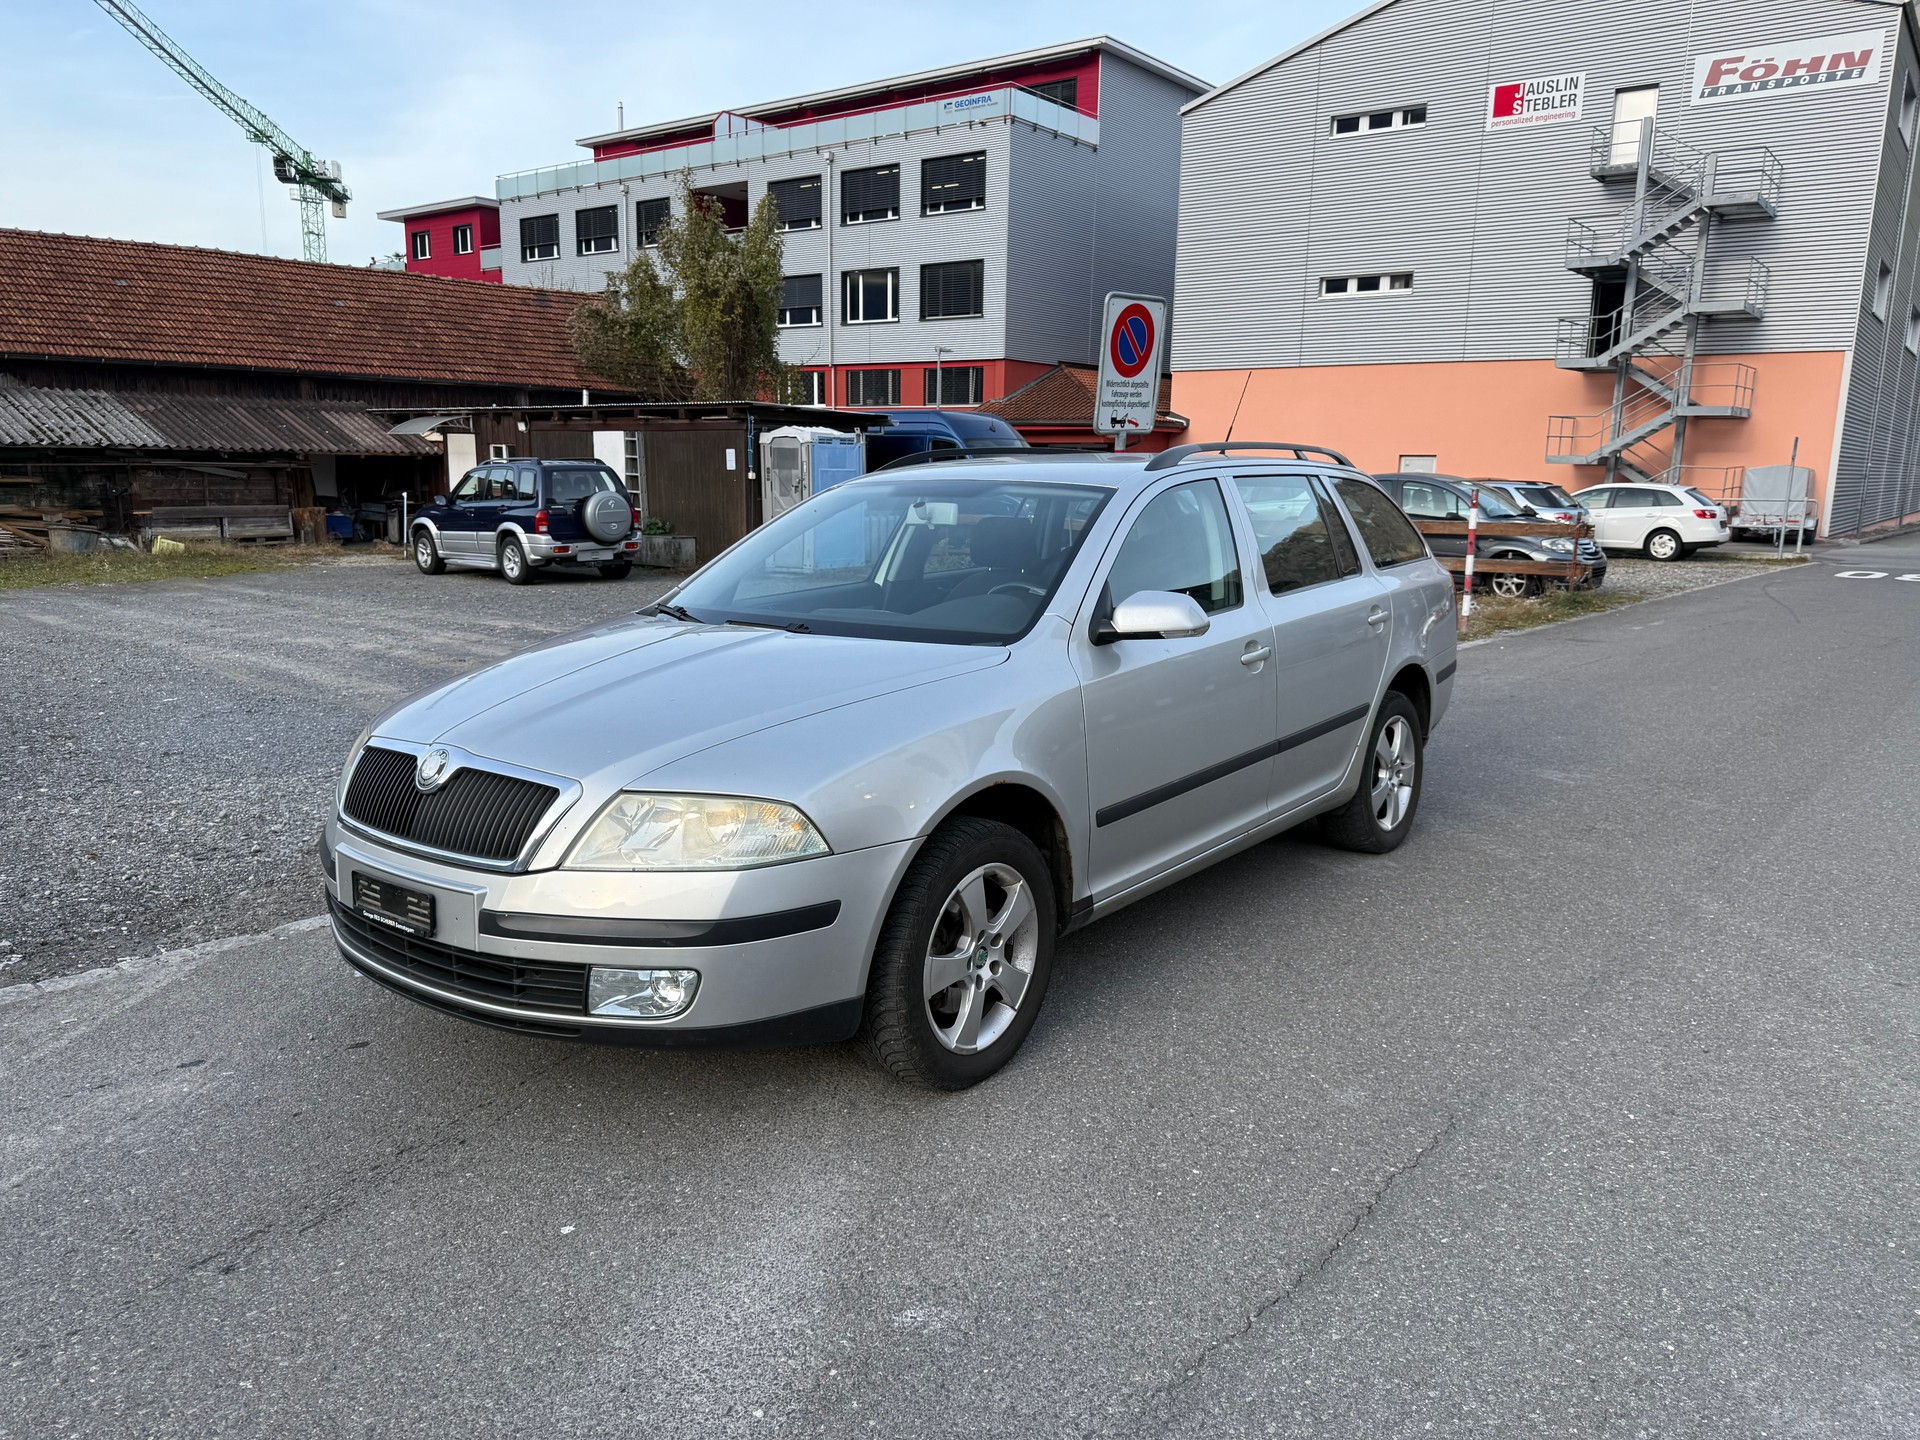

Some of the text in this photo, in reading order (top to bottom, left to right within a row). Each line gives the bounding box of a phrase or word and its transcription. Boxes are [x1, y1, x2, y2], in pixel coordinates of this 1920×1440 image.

[1703, 48, 1874, 87] FÖHN
[1514, 76, 1579, 98] JAUSLIN
[1702, 68, 1863, 97] TRANSPORTE
[954, 96, 992, 108] GEOINFRA
[1512, 93, 1577, 115] STEBLER
[1491, 110, 1576, 128] personalized engineering
[1106, 380, 1149, 390] Widerrechtlich abgestellte
[1111, 390, 1128, 399] Fahrzeuge
[1102, 400, 1126, 409] kostenpflichtig
